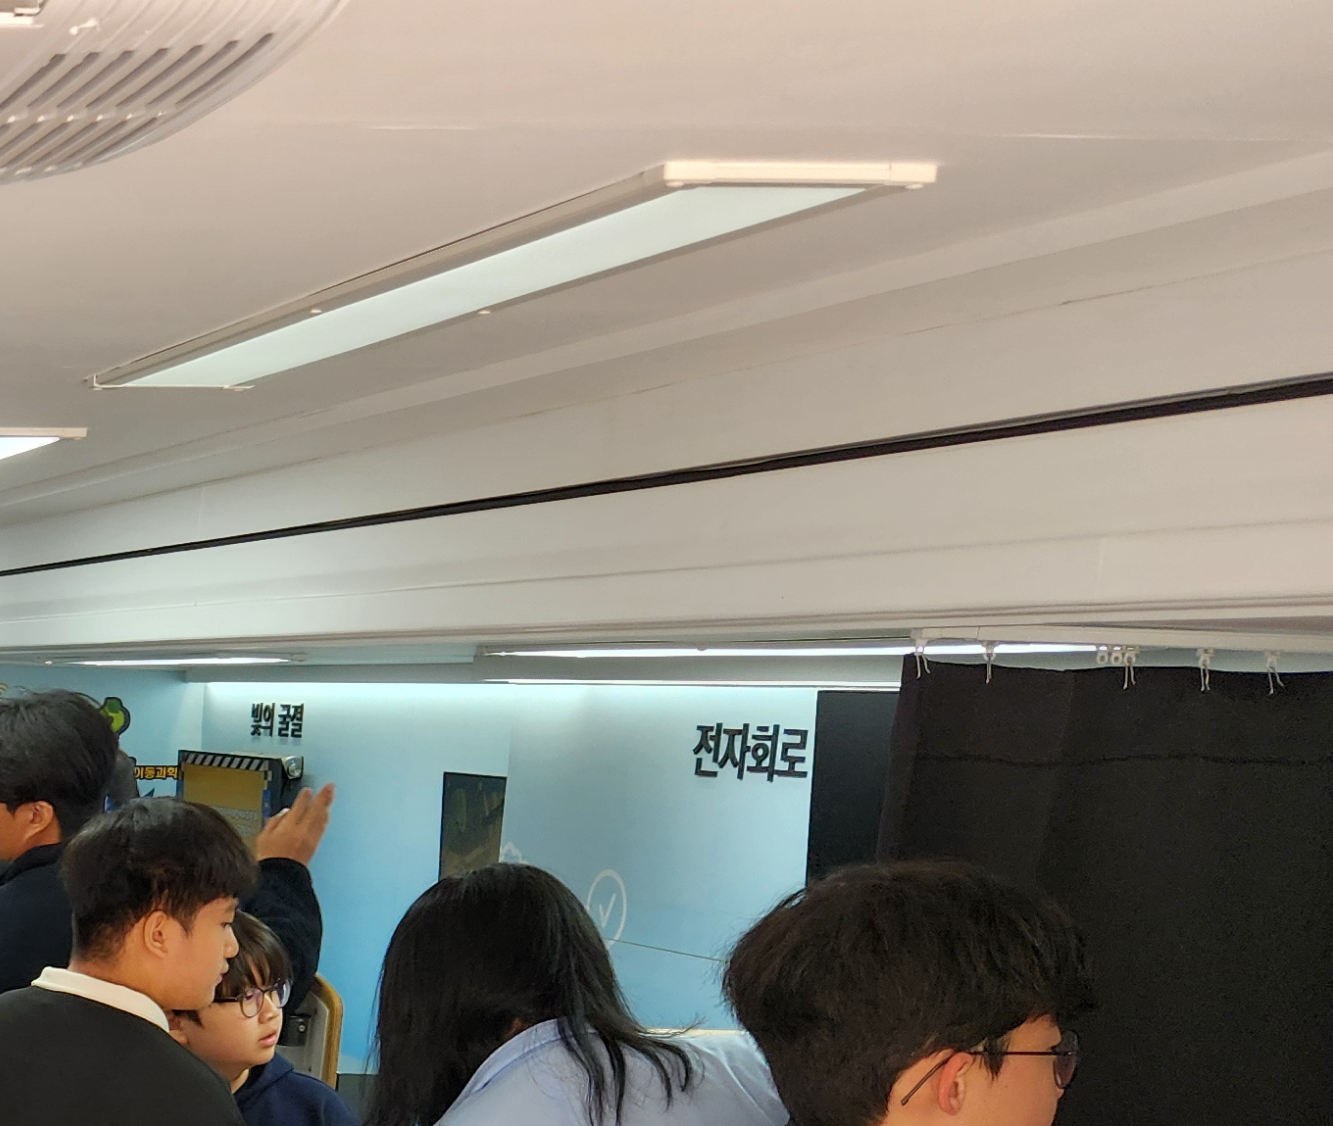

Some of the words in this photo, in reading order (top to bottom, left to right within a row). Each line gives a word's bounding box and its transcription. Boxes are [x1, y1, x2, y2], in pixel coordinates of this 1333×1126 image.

[251, 702, 275, 737] 빛의
[278, 703, 305, 738] 굴절
[693, 722, 808, 783] 전자회로
